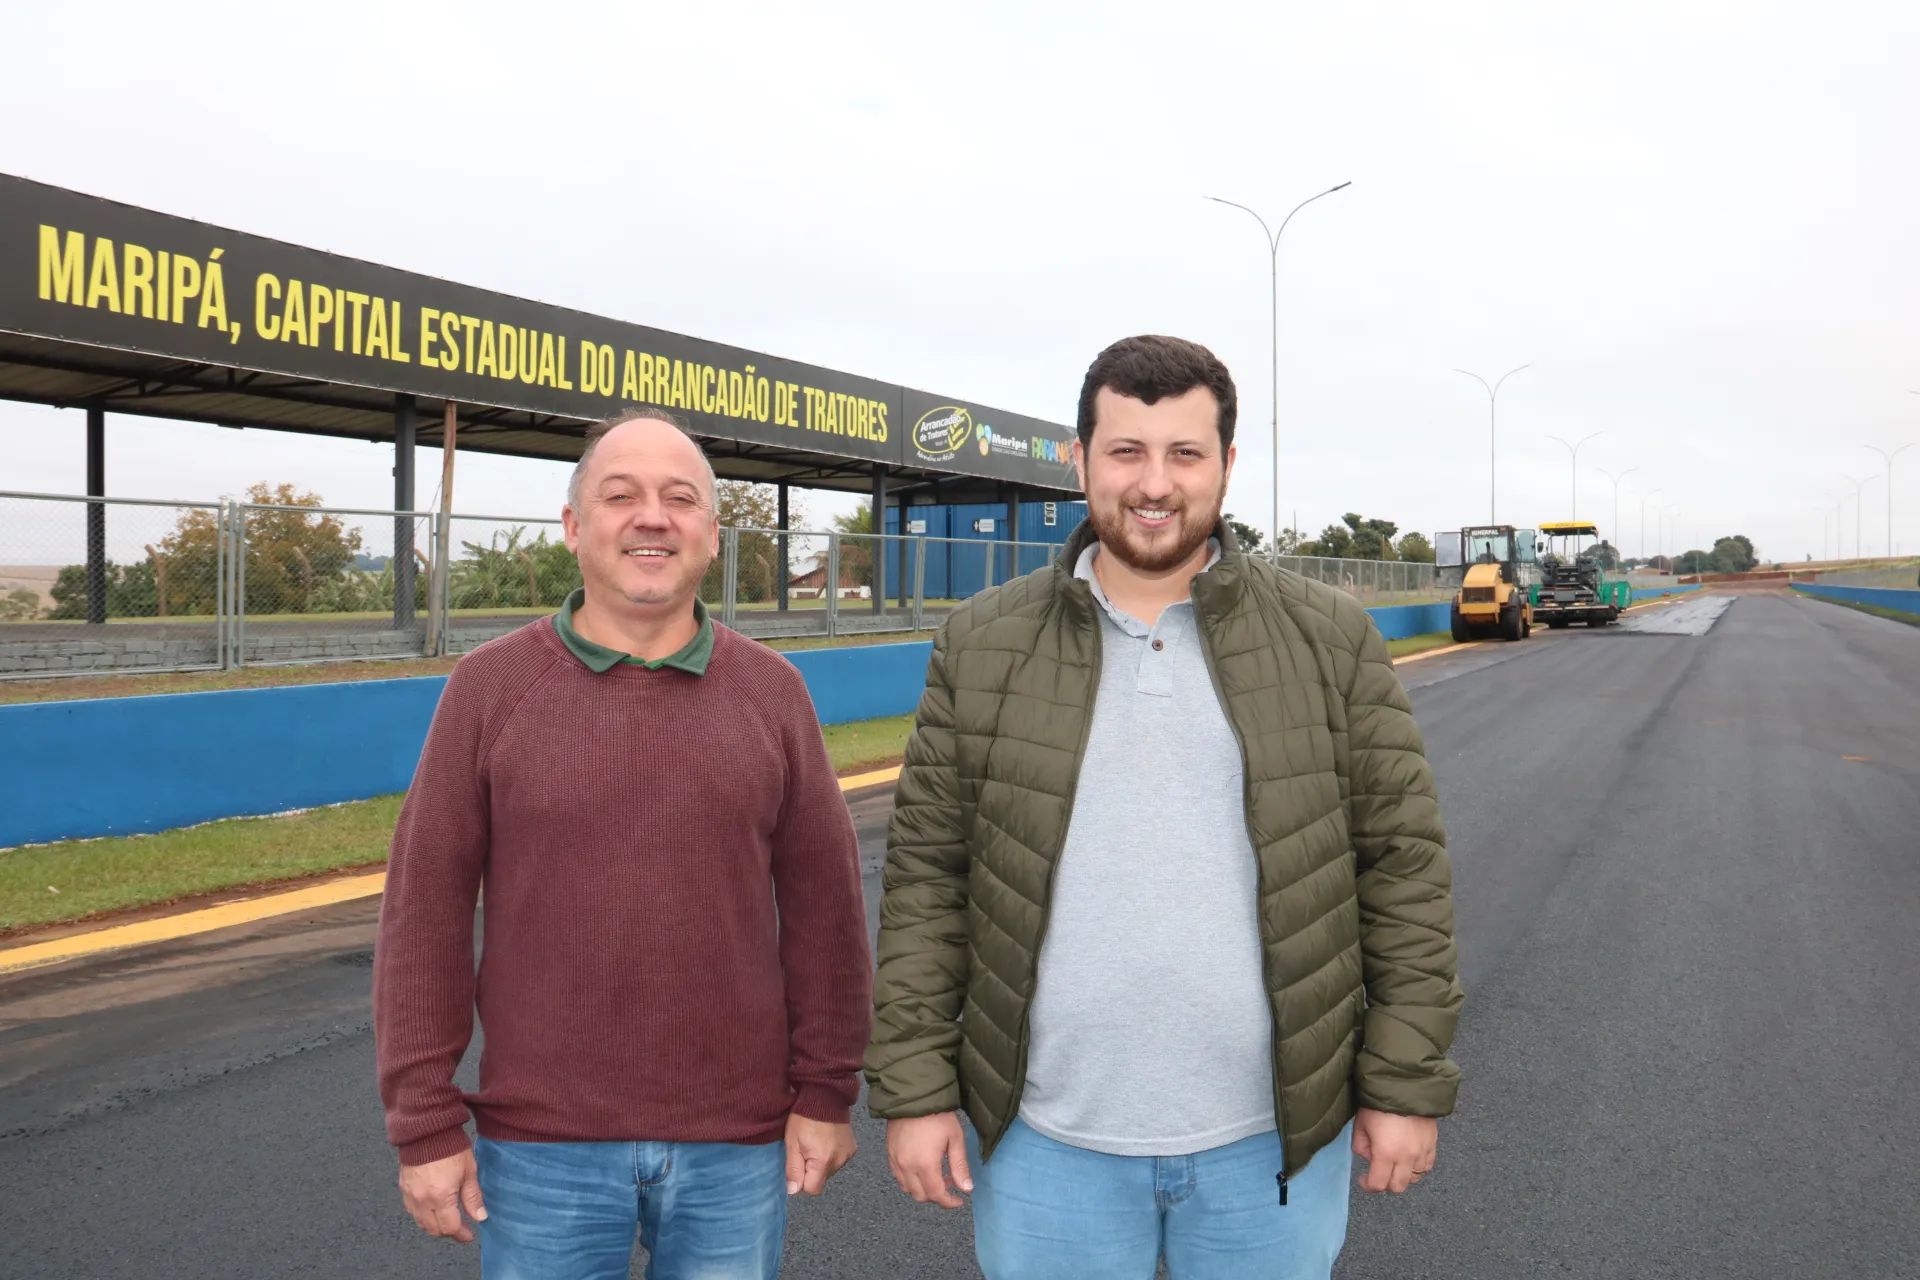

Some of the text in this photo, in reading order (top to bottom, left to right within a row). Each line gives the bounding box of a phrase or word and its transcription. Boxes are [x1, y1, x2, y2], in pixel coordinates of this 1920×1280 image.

[38, 224, 888, 443] MARIPÁ, CAPITAL ESTADUAL DO ARRANCADÃO DE TRATORES
[920, 415, 961, 433] Arrancadão
[919, 433, 928, 443] de
[927, 428, 949, 441] Tratores
[992, 433, 1028, 450] Maripá
